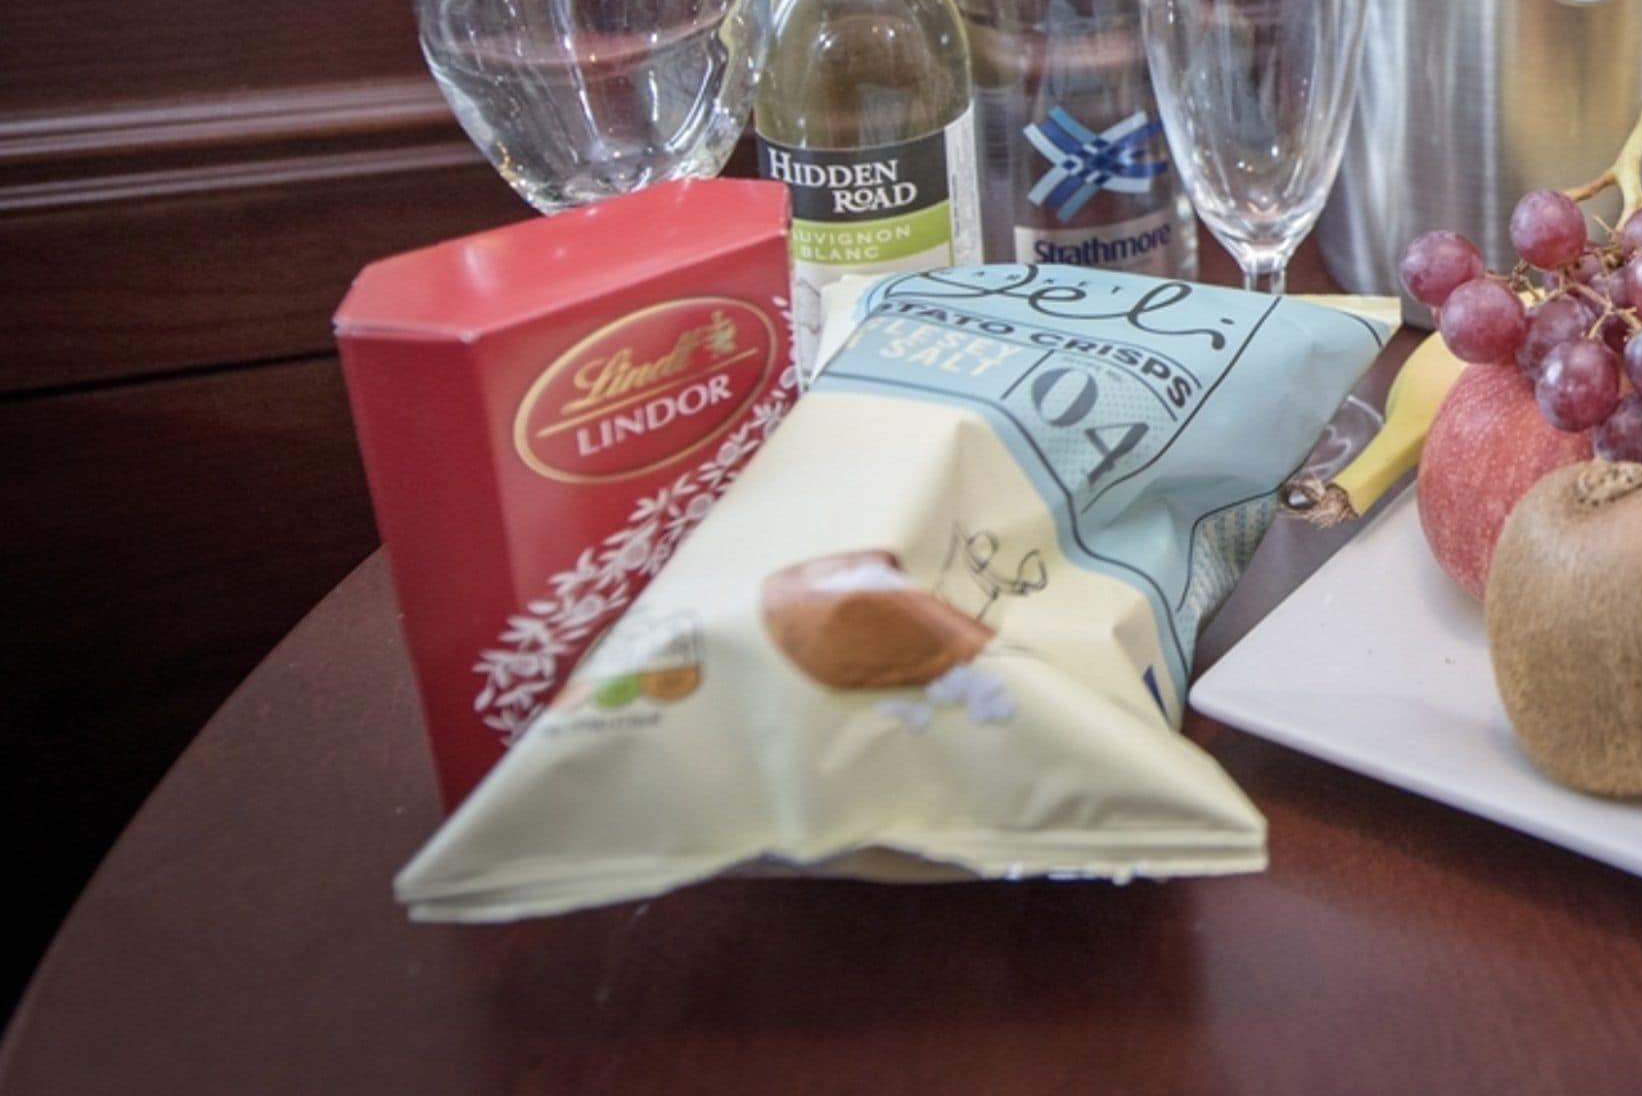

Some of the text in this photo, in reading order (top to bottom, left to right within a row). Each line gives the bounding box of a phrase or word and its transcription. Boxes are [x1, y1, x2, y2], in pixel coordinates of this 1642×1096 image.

[767, 147, 899, 188] HIDDEN
[832, 182, 918, 213] ROAD
[793, 224, 912, 246] UVIGNON
[800, 246, 880, 260] BLANC
[1034, 224, 1172, 266] Strathmore
[972, 270, 1123, 296] ARKET
[561, 318, 706, 415] Lindt
[880, 302, 1015, 335] TATO
[1030, 332, 1193, 408] CRISPS
[880, 337, 994, 376] SALT
[576, 373, 732, 456] LINDOR
